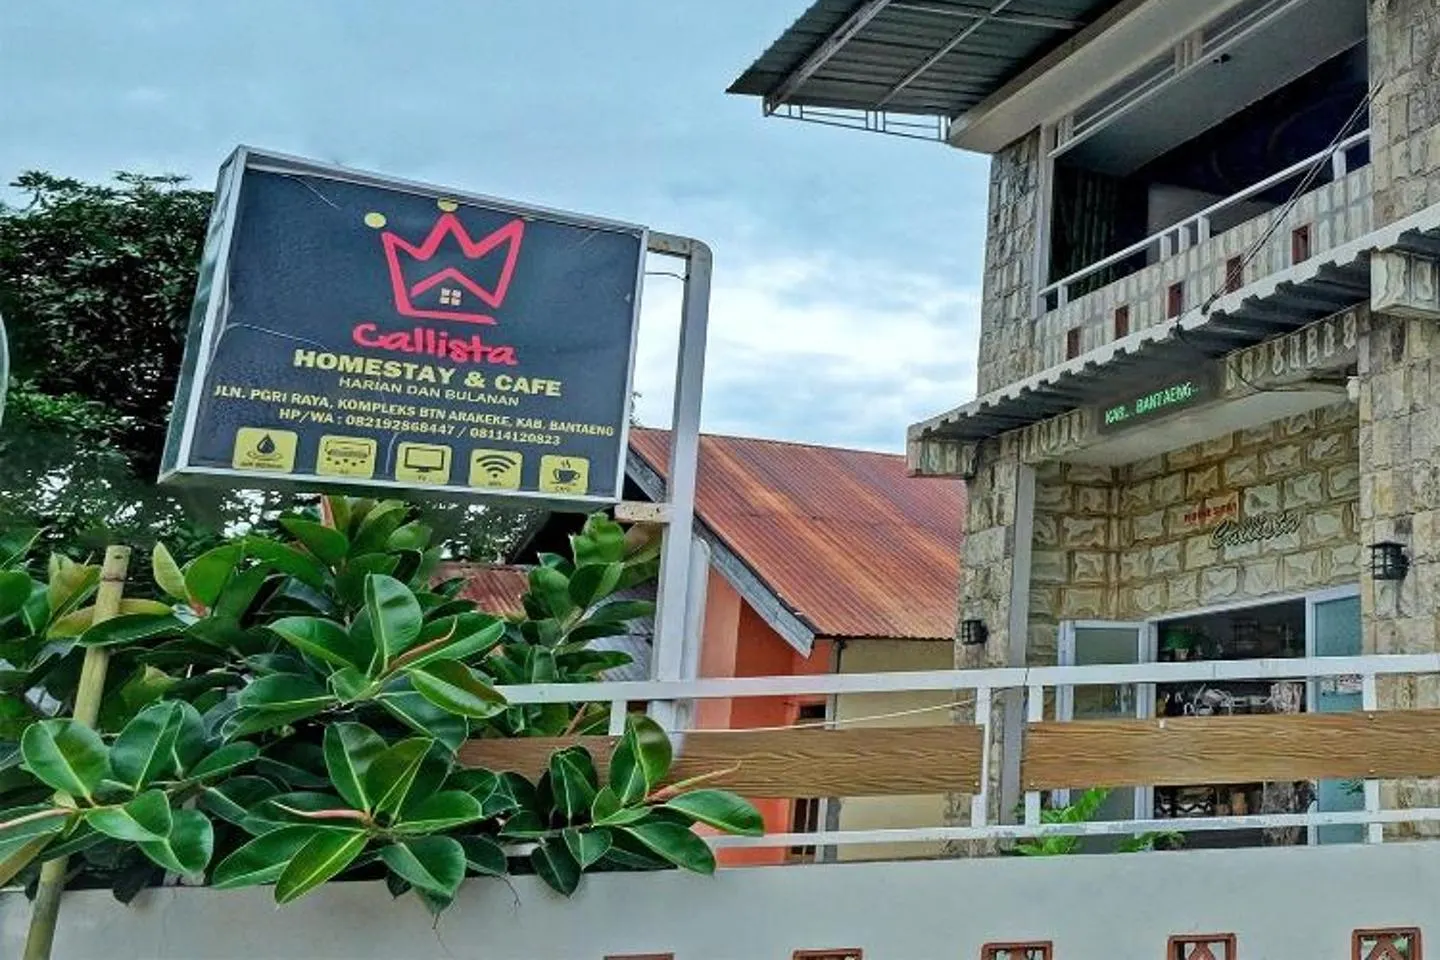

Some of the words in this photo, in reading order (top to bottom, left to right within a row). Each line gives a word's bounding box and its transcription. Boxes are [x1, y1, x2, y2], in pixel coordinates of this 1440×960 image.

[352, 323, 519, 366] Callista
[293, 348, 456, 385] HOMESTAY
[463, 371, 486, 389] &
[495, 375, 563, 397] CAFE
[338, 377, 402, 394] HARIAN
[406, 385, 441, 399] DAN
[445, 390, 520, 407] BULANAN
[213, 385, 246, 400] JLN.
[250, 388, 287, 403] PGRI
[337, 399, 416, 417] KOMPLEKS
[419, 408, 446, 420] BTN
